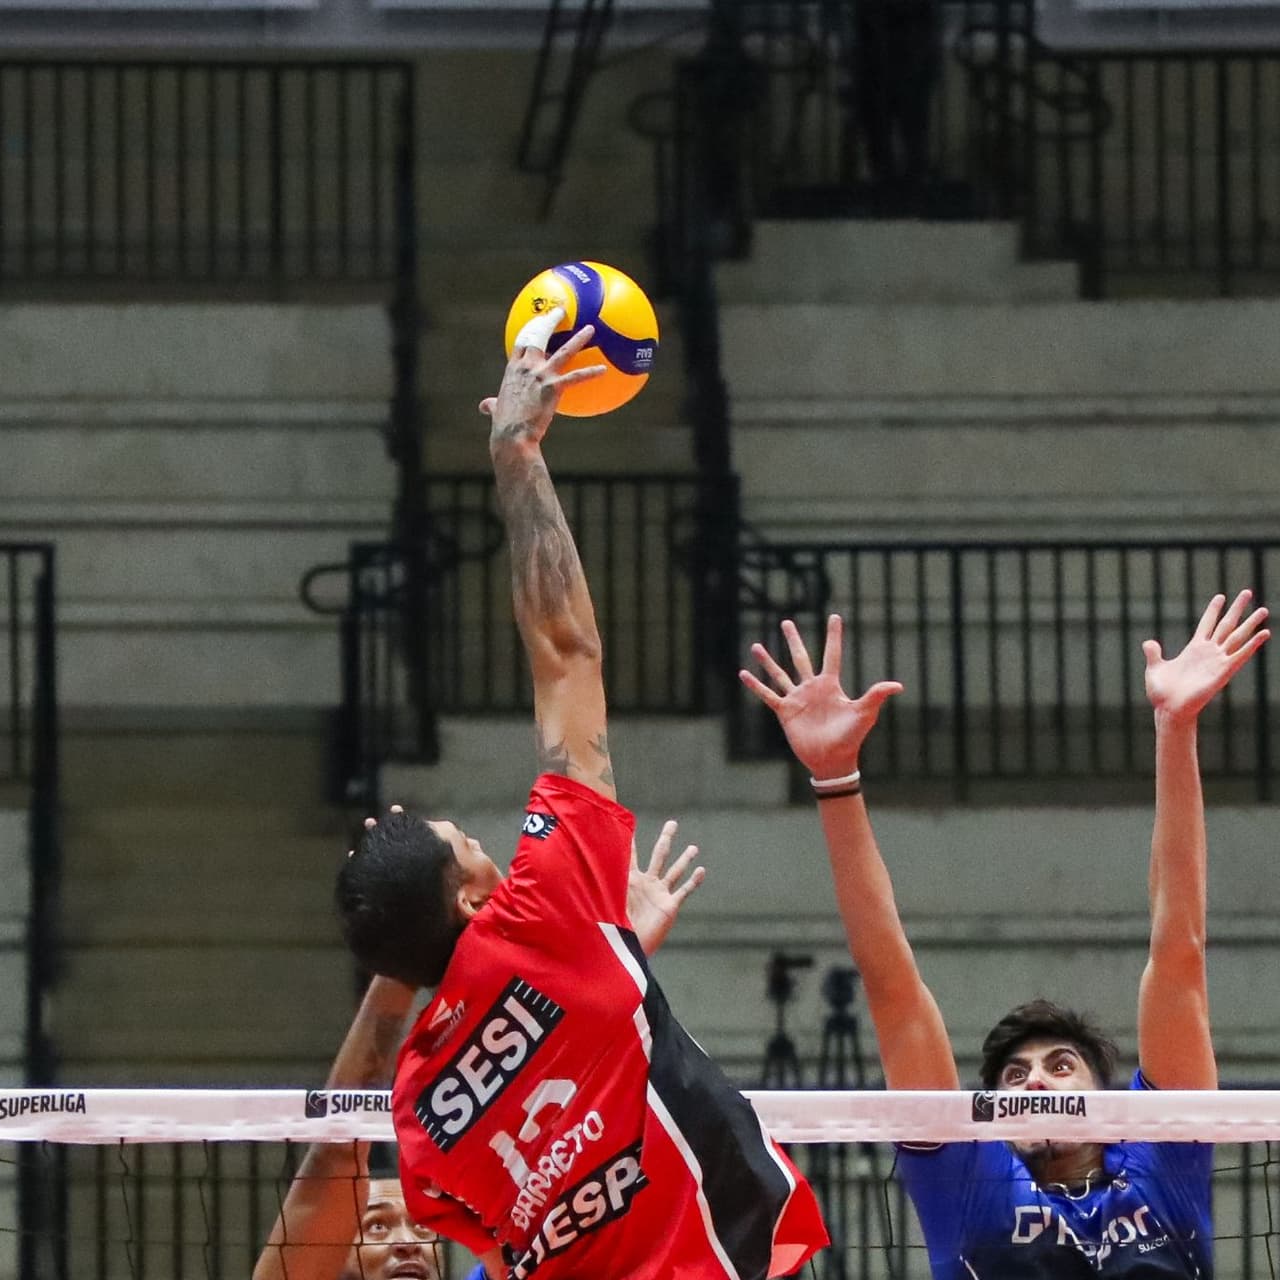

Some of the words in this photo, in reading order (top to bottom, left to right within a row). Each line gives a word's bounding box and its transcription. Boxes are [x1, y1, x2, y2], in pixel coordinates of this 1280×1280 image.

[431, 996, 544, 1136] SESI
[0, 1094, 86, 1115] SUPERLIGA
[331, 1095, 391, 1114] SUPERL
[999, 1097, 1086, 1118] SUPERLIGA
